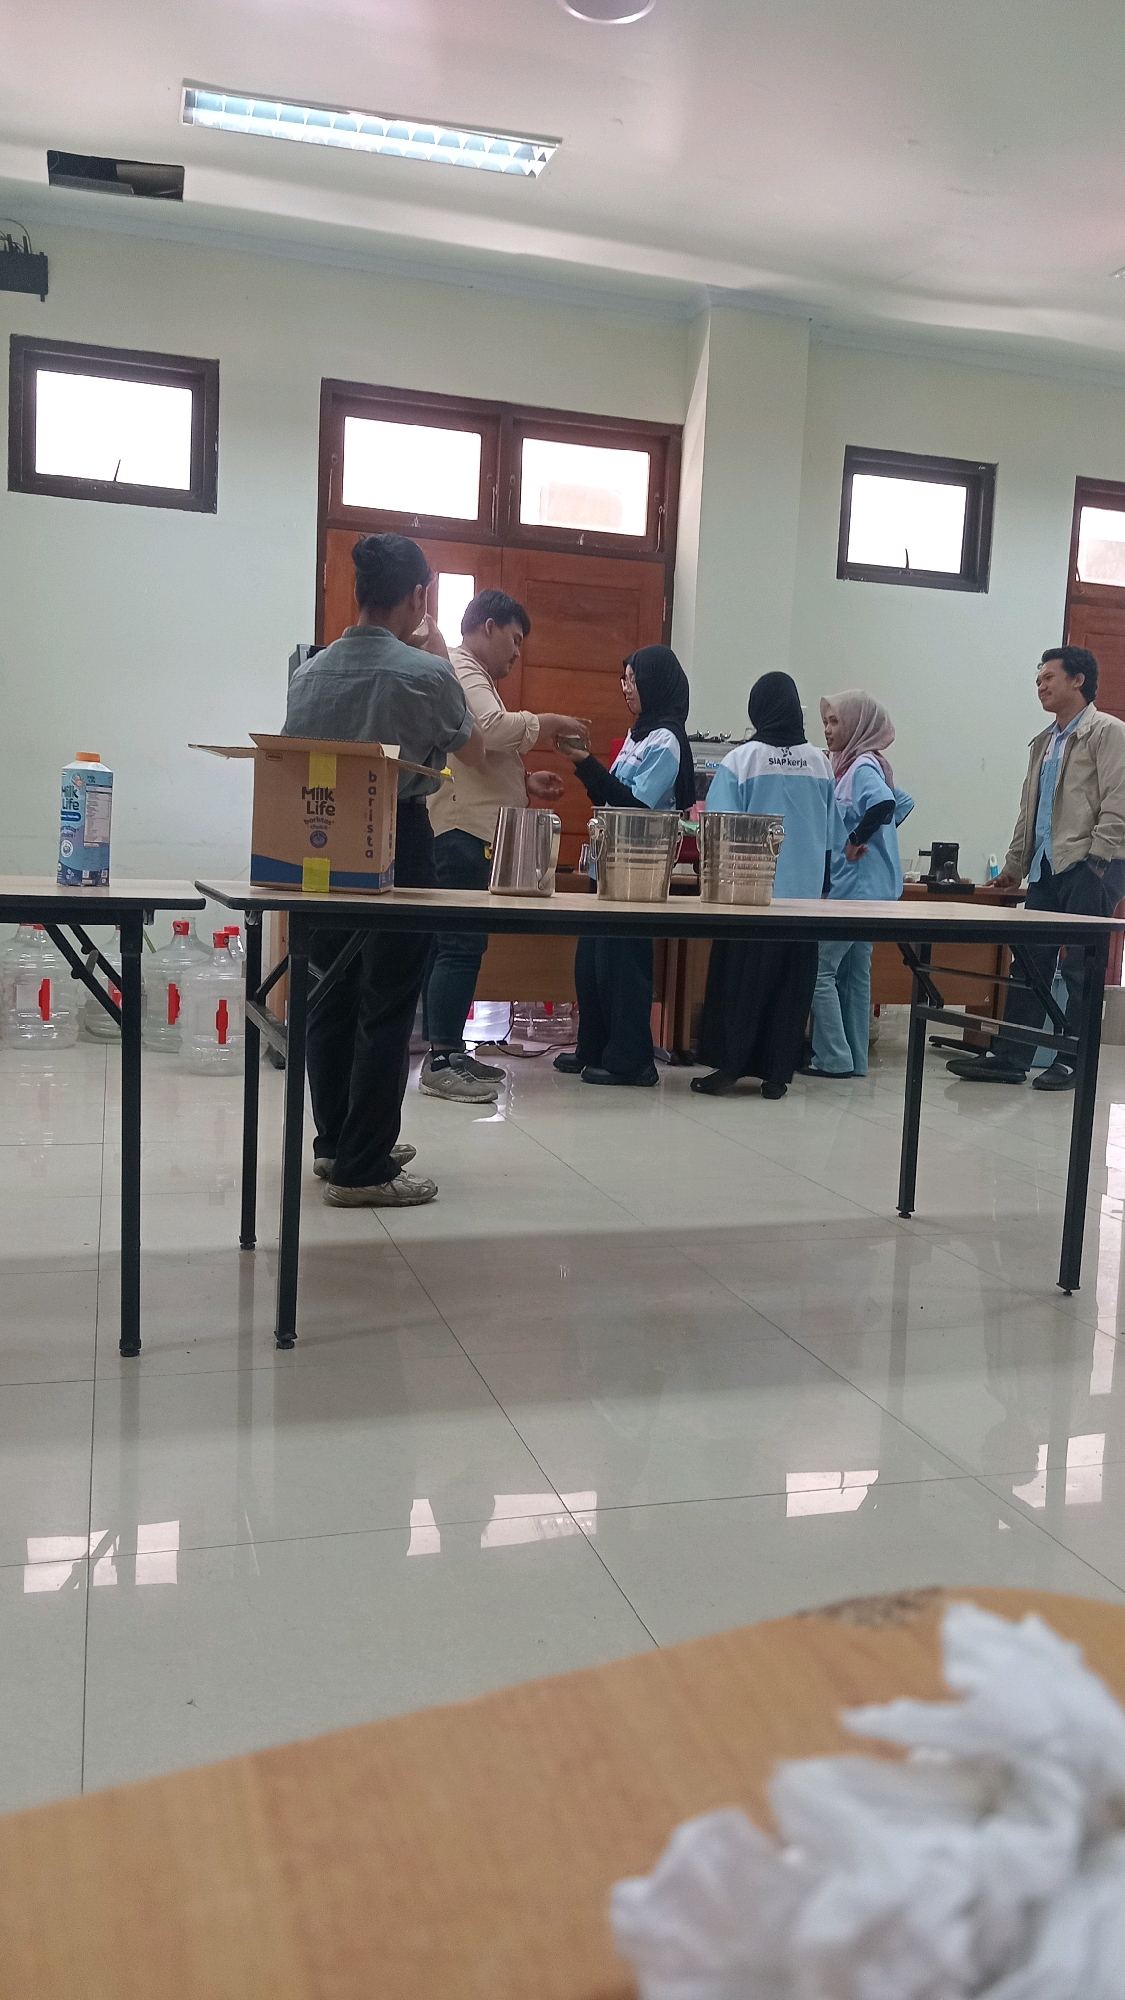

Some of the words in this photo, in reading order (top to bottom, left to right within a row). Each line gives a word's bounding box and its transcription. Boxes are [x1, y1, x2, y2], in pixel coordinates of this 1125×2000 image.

[301, 785, 335, 802] Milk
[306, 800, 336, 816] Life
[365, 770, 377, 859] barista
